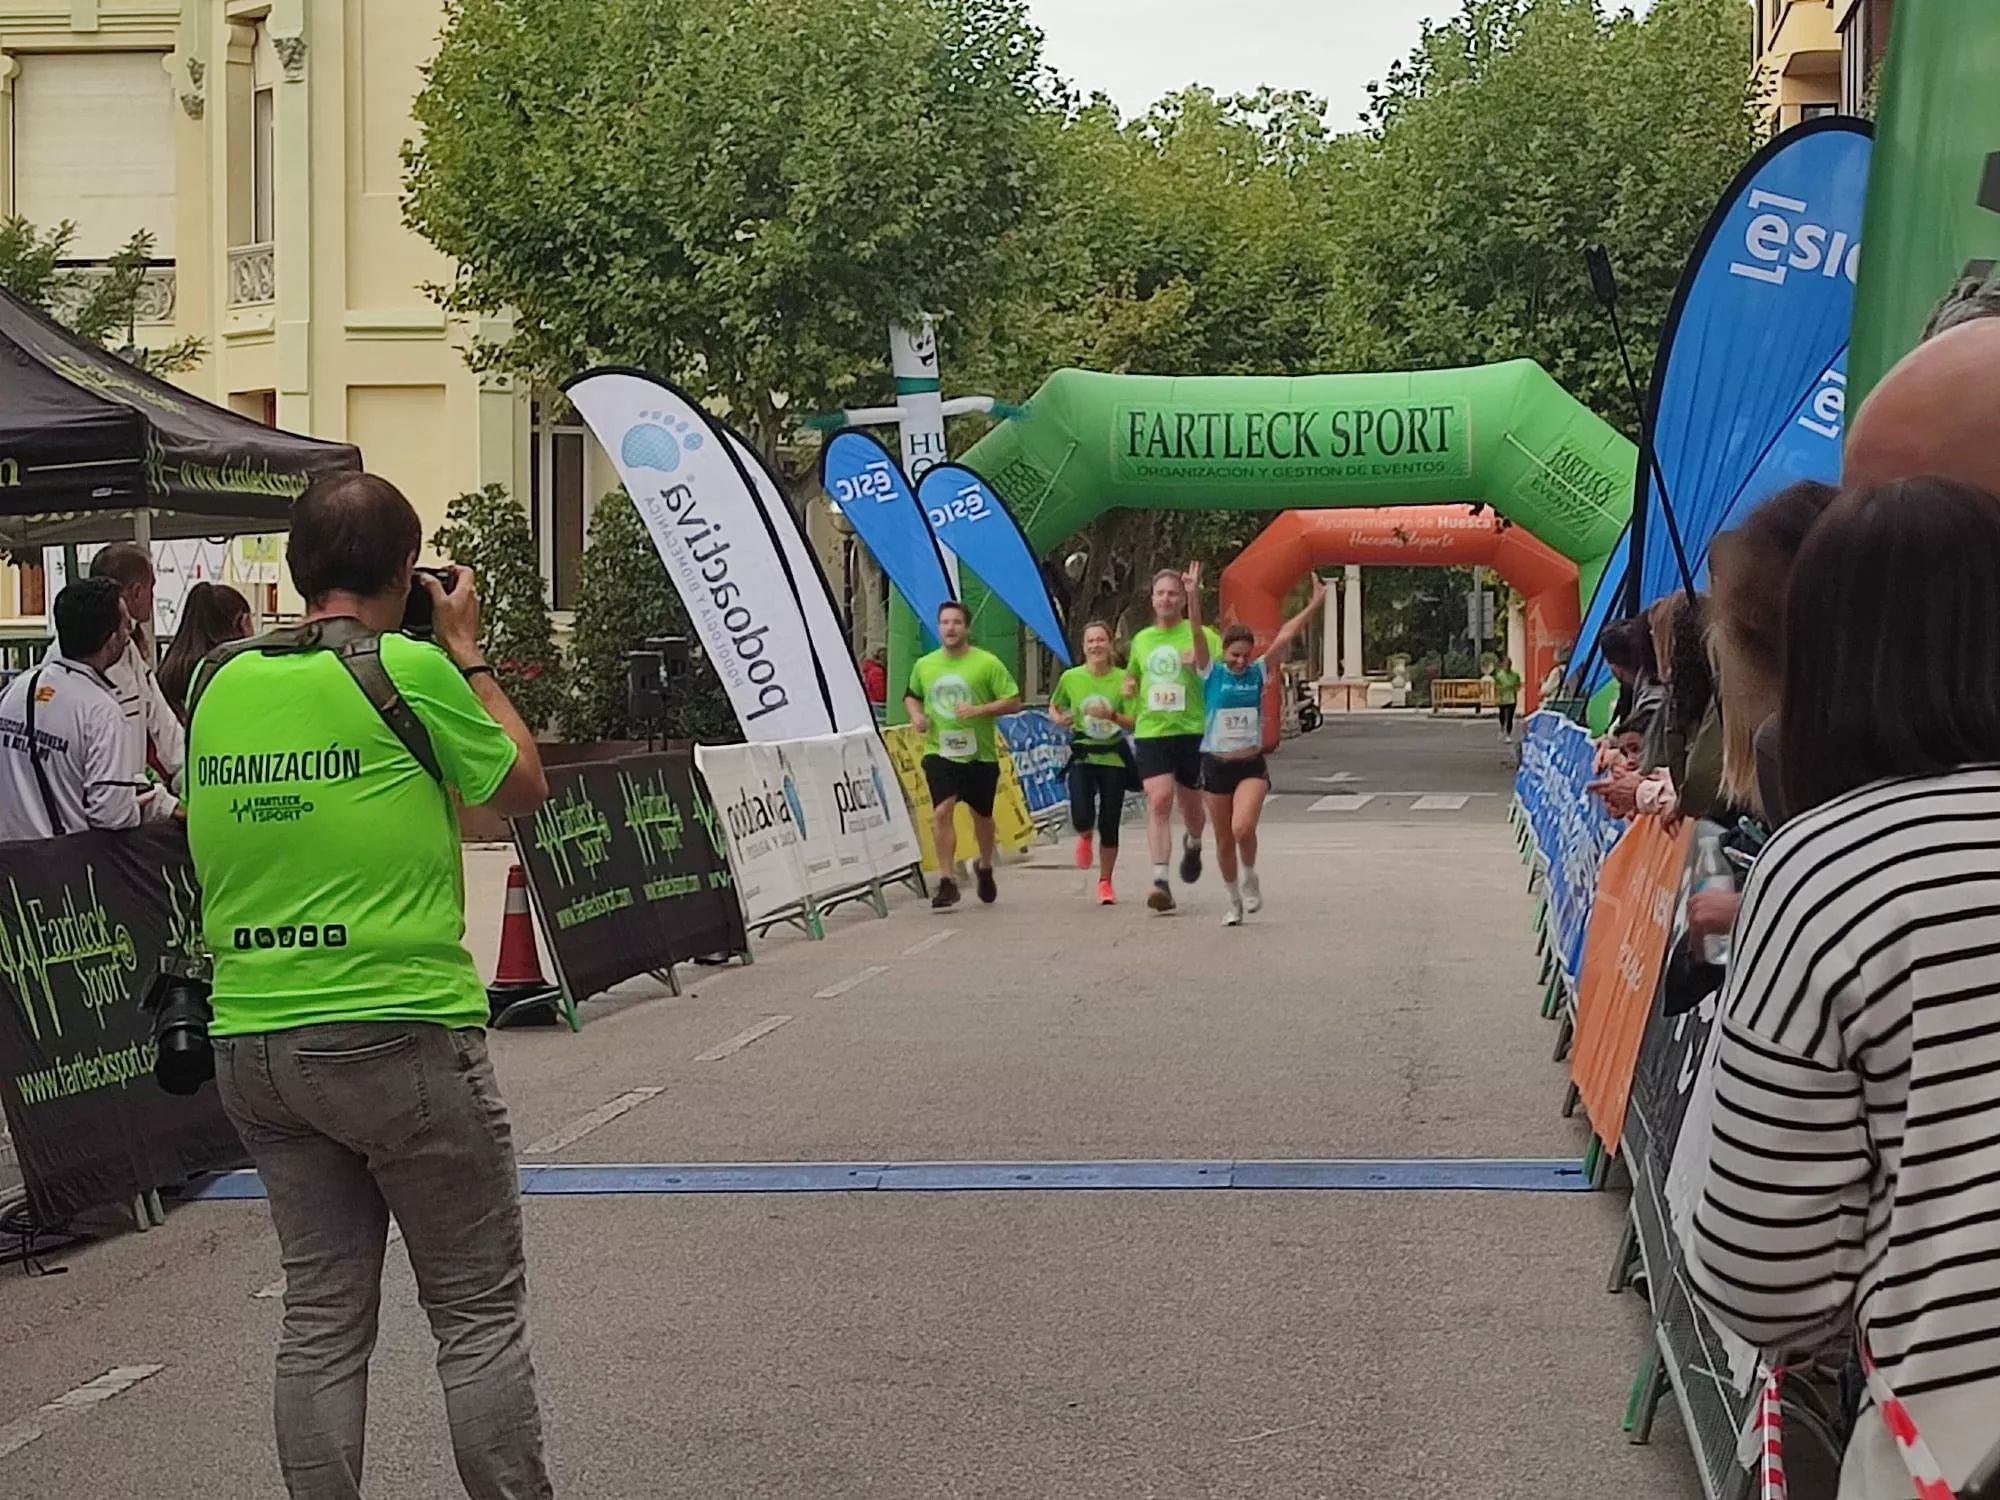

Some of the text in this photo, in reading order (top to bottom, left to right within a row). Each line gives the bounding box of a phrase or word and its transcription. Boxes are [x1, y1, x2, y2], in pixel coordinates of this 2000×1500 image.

[1127, 405, 1455, 459] FARTLECK SPORT
[1346, 463, 1369, 476] DE
[1371, 459, 1447, 476] EVENTOS
[1418, 517, 1434, 529] de
[1437, 516, 1492, 529] Huesca
[199, 743, 361, 786] ORGANIZACIÓN
[254, 795, 301, 807] FARTLECK
[257, 809, 301, 822] SPORT
[27, 863, 112, 955] Fartleck
[72, 957, 131, 1030] Sport
